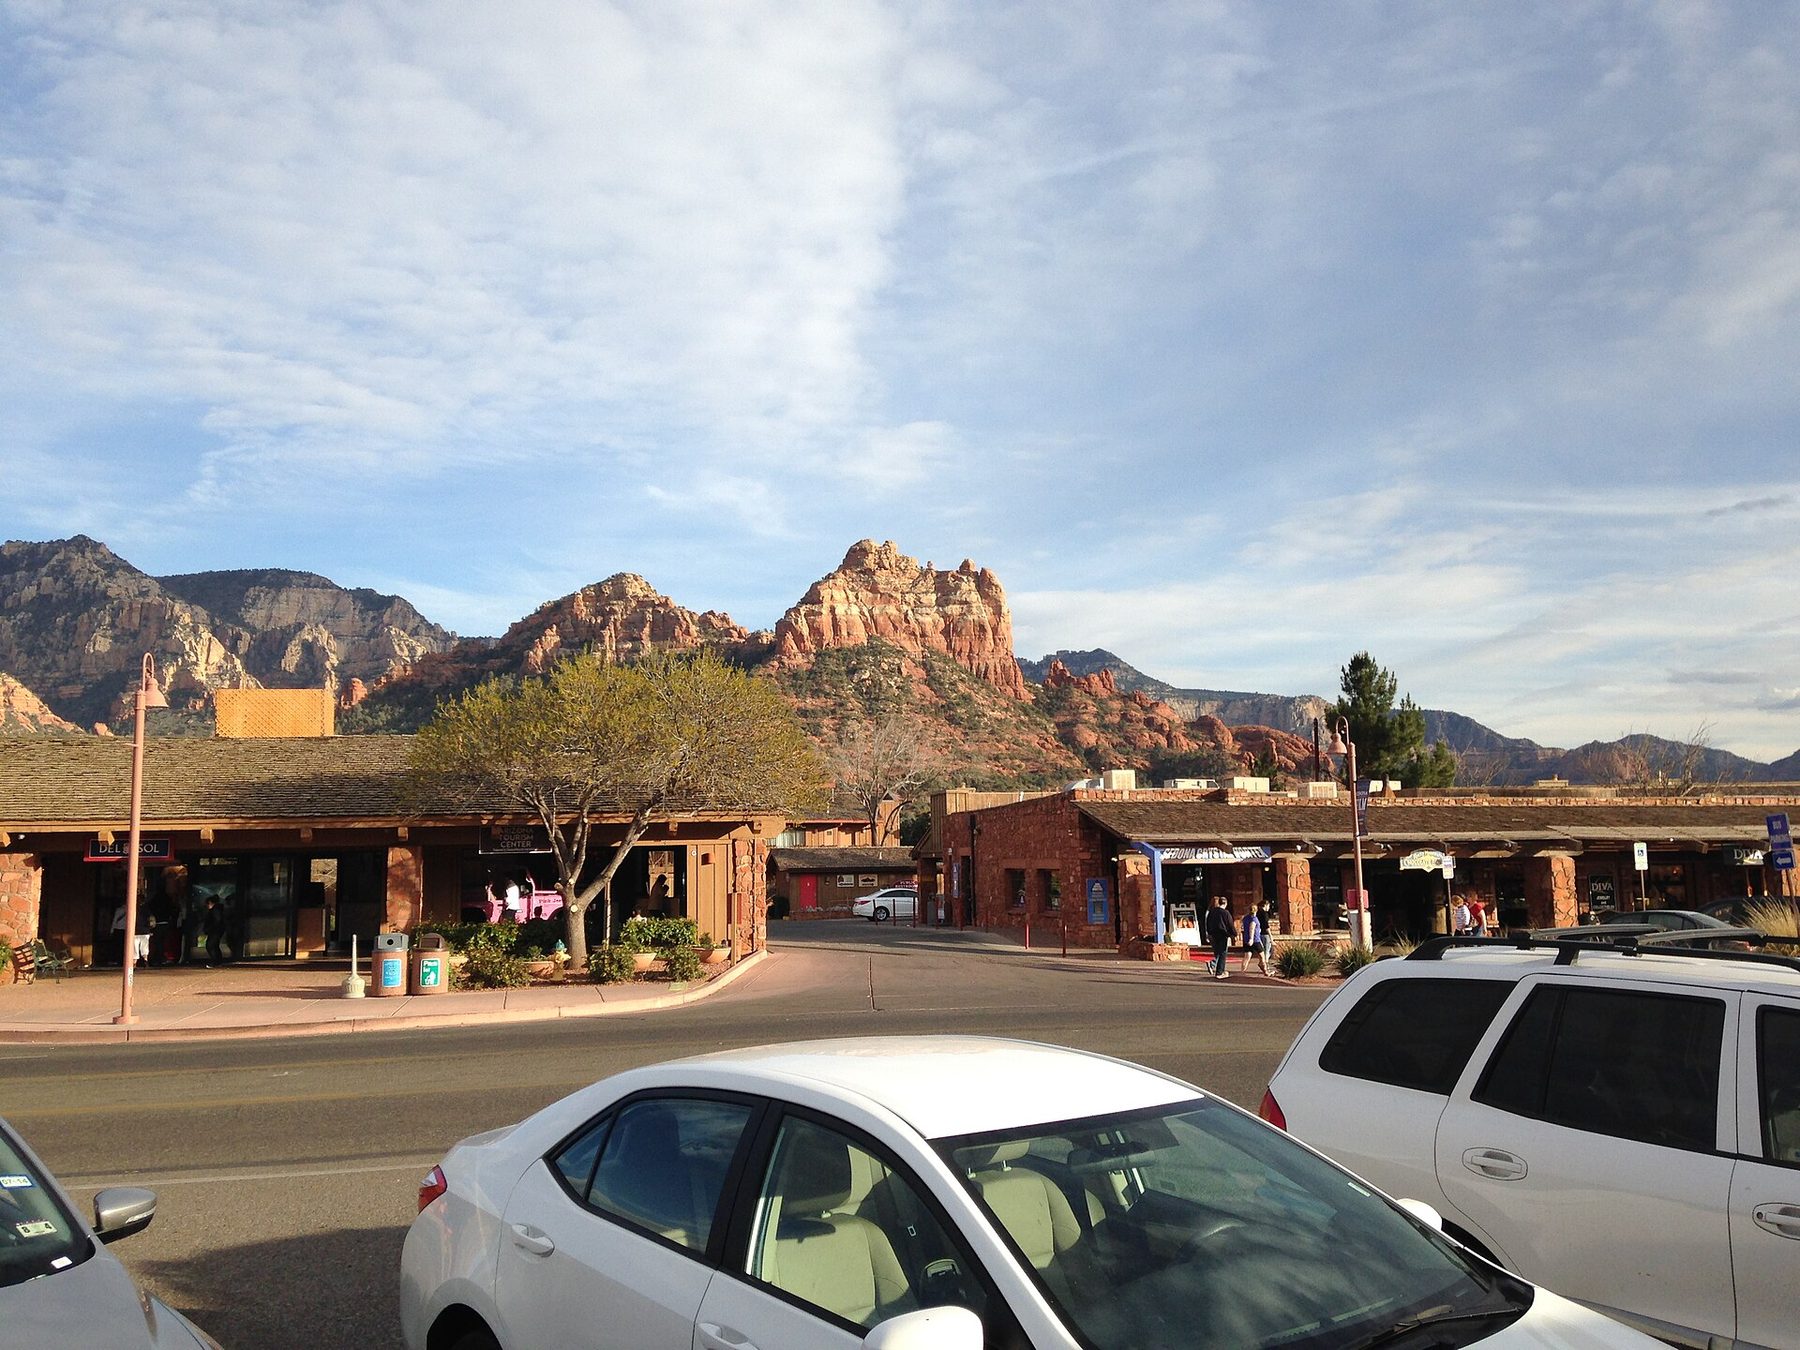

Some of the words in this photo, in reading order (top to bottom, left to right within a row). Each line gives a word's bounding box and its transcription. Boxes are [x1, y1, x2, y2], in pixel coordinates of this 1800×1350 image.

[99, 843, 121, 853] DEL
[138, 843, 160, 853] SOL
[500, 840, 532, 849] CENTER
[1162, 847, 1196, 860] SEDONA
[1733, 848, 1764, 860] DIVA
[1591, 882, 1614, 891] DIVA
